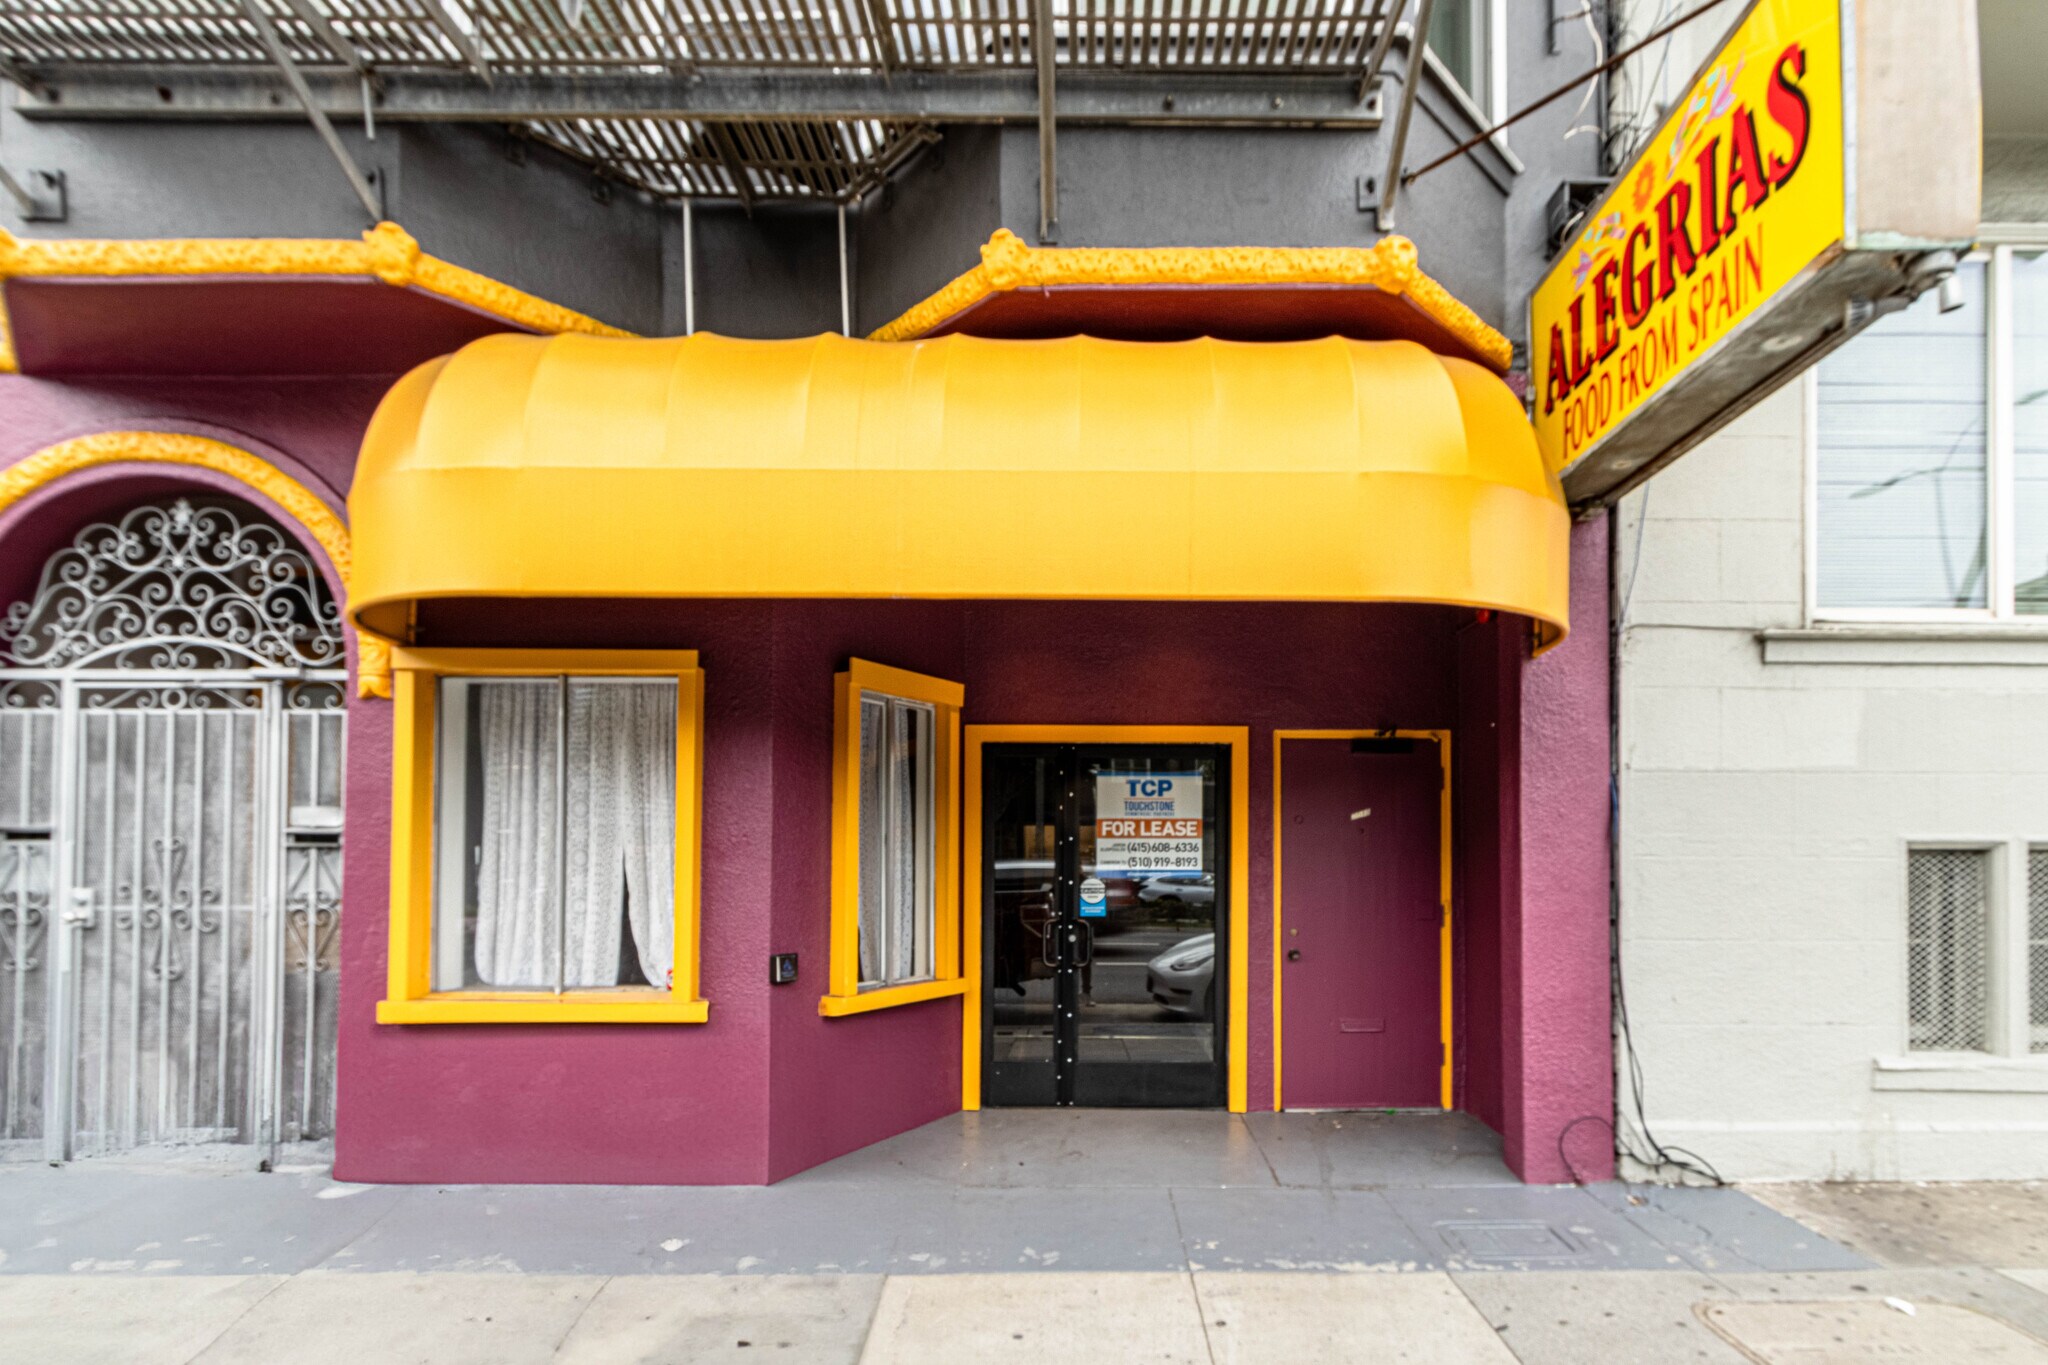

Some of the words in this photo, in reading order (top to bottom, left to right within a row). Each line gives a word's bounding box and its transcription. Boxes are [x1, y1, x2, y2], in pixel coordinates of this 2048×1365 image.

[1544, 42, 1811, 416] ALEGRIAS
[1563, 371, 1612, 459] FOOD
[1619, 305, 1678, 411] FROM
[1688, 222, 1763, 352] SPAIN
[1127, 779, 1173, 797] TCP
[1124, 801, 1175, 811] TOUCHSTONE
[1101, 821, 1136, 836] FOR
[1140, 821, 1198, 836] LEASE
